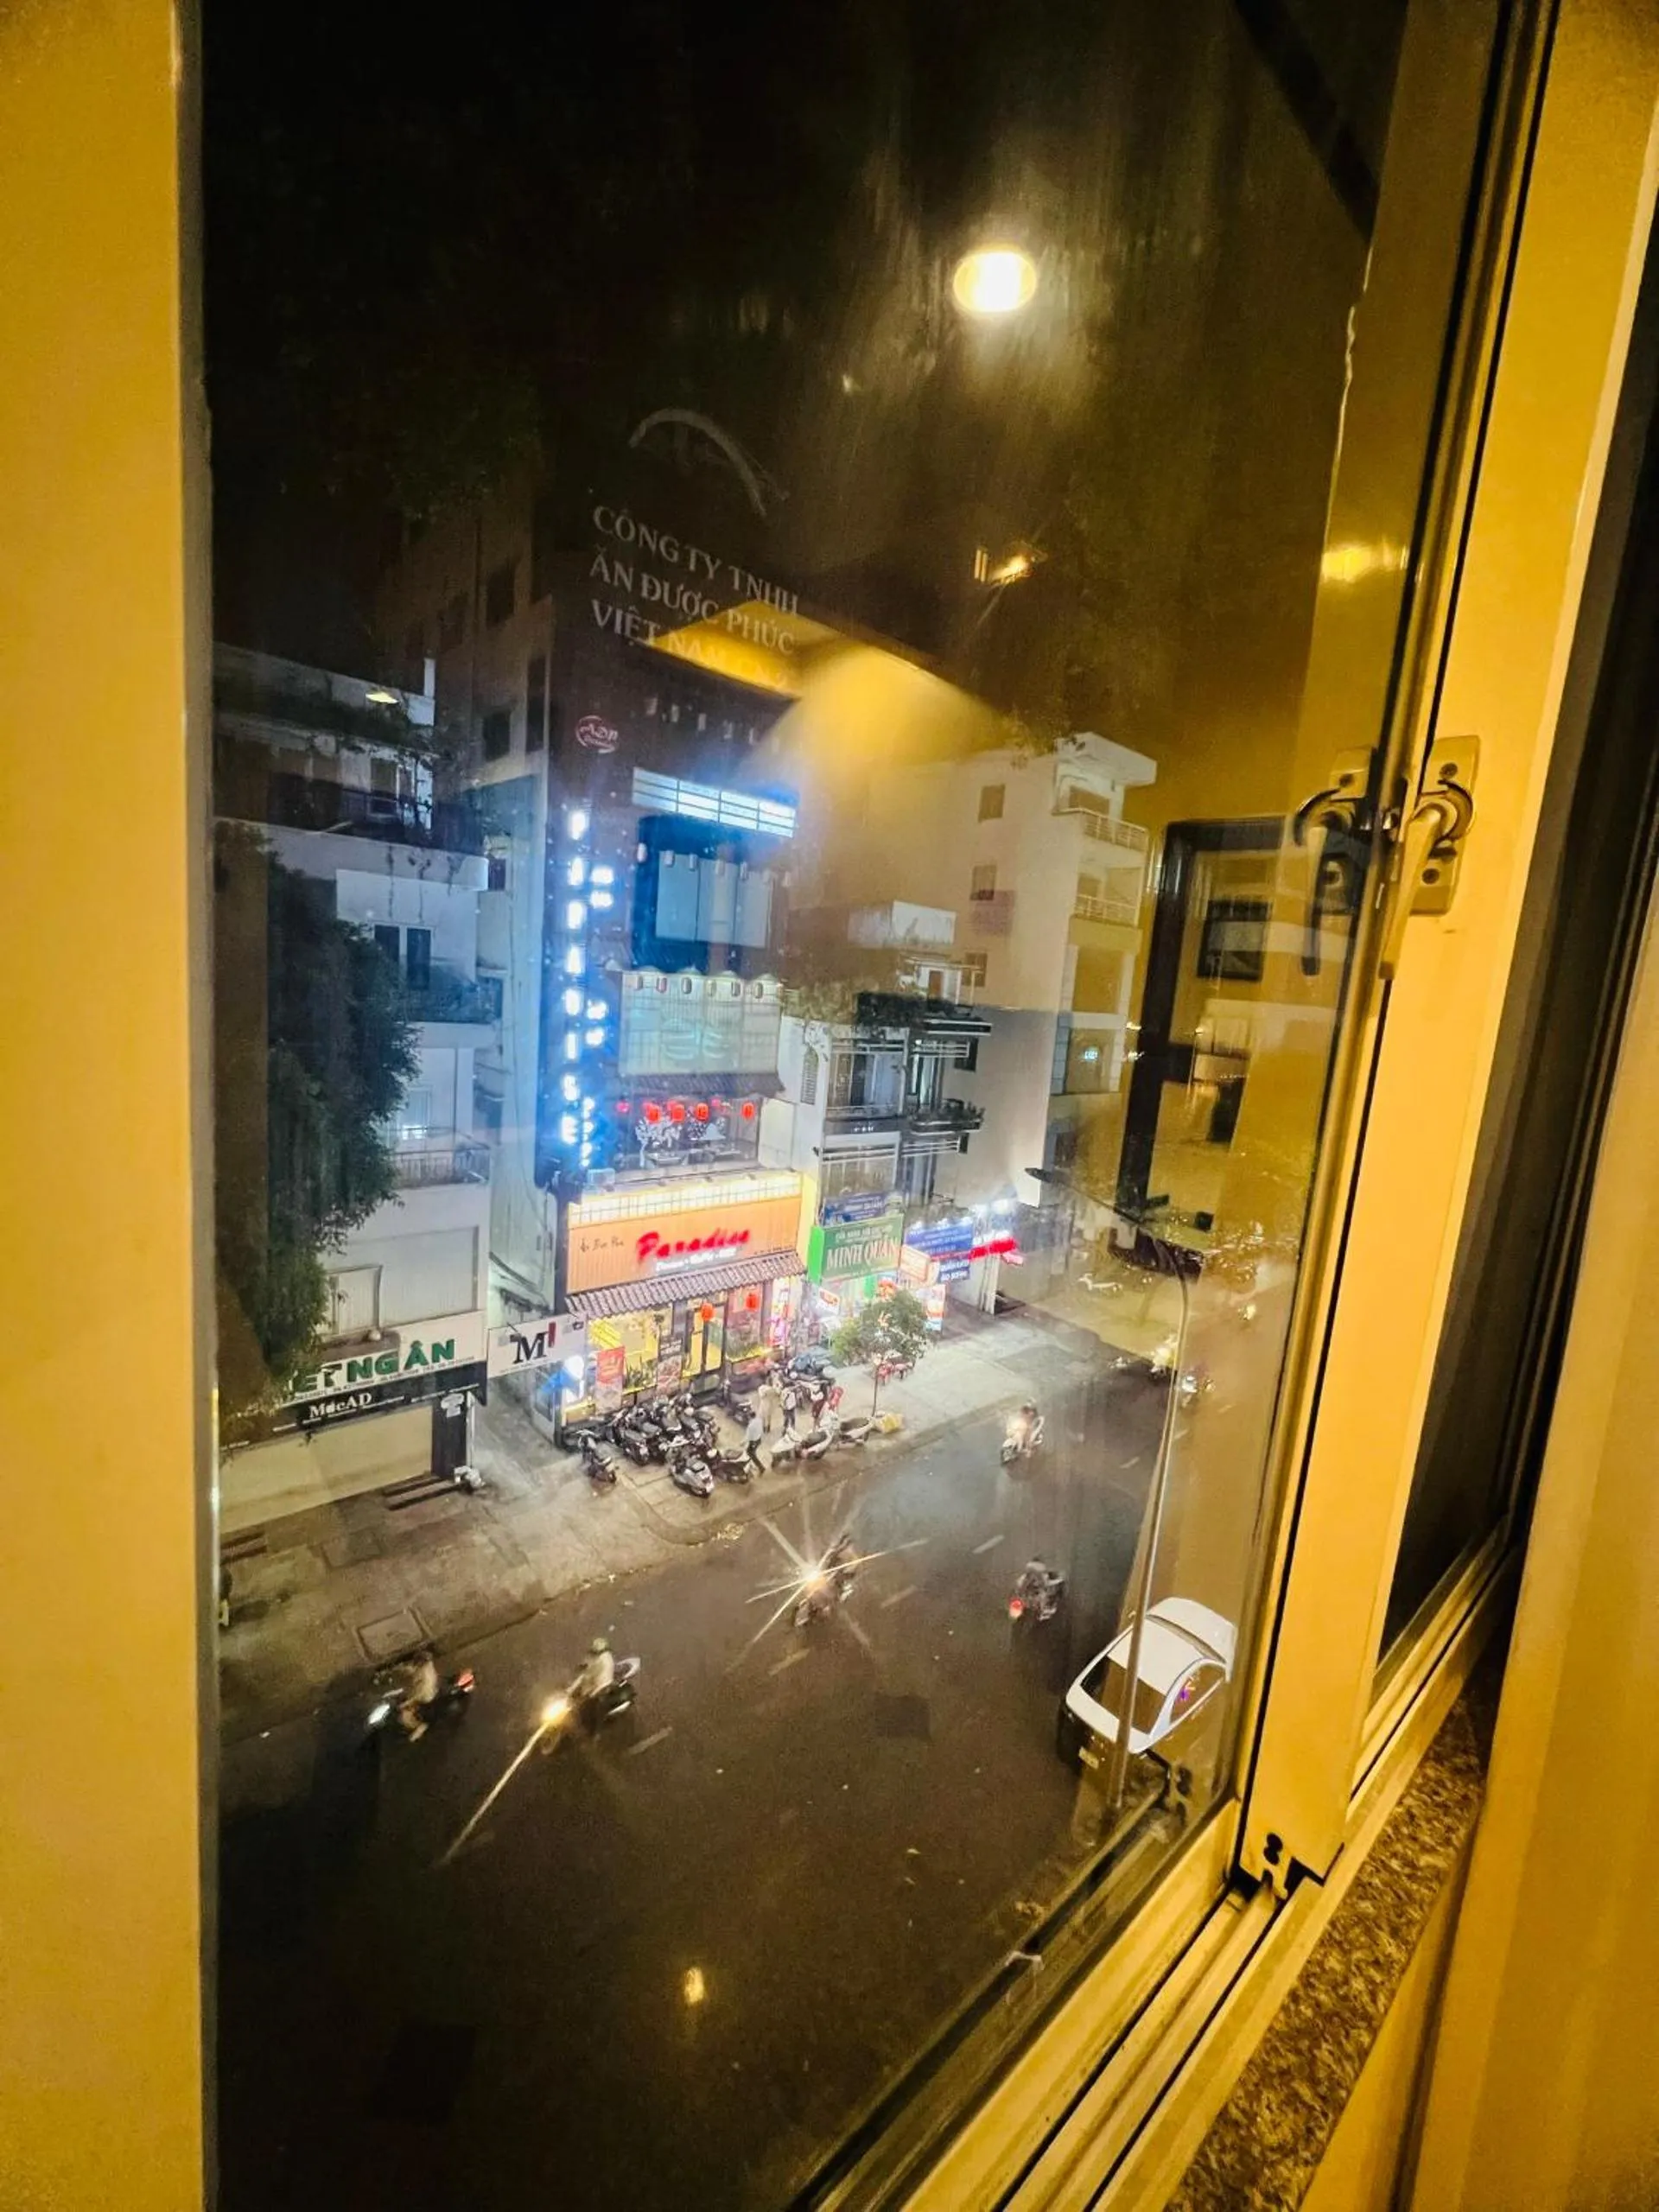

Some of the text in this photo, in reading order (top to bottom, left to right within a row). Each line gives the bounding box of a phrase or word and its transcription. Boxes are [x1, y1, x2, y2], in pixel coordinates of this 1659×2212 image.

[593, 505, 798, 617] CÔNG TY TNHH
[591, 598, 661, 647] VIỆT
[346, 1338, 456, 1382] NGÂN
